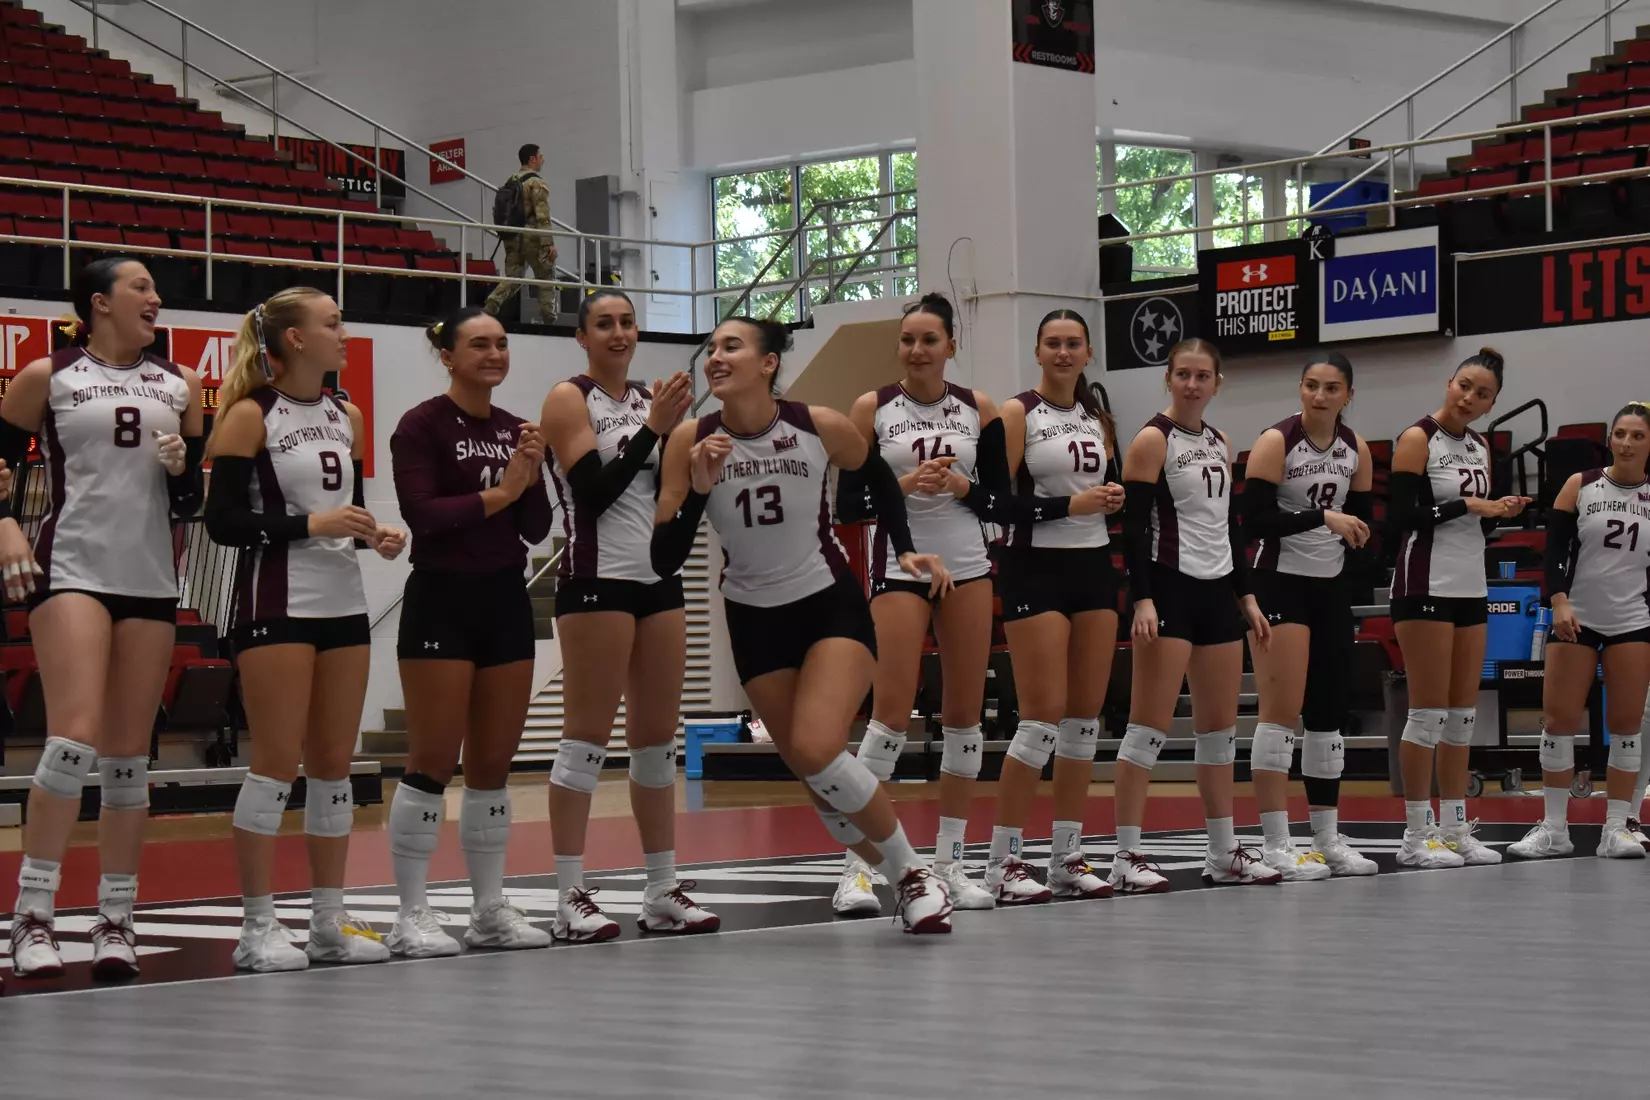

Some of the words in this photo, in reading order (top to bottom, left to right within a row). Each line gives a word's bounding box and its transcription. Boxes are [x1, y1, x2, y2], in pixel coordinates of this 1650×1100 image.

[1031, 50, 1078, 66] RESTROOMS
[1309, 239, 1325, 261] K
[1333, 268, 1427, 305] DASANI
[1542, 245, 1650, 324] LETS
[1216, 285, 1297, 316] PROTECT
[1215, 316, 1246, 337] THIS
[1249, 311, 1299, 334] HOUSE.
[72, 385, 129, 407] SOUTHERN
[114, 407, 141, 448] 8
[596, 414, 629, 435] OUTHERN
[889, 420, 934, 438] SOUTHERN
[936, 418, 971, 436] ILLINOIS
[1042, 423, 1079, 441] SOUTHERN
[278, 426, 323, 453] SOUTHERN
[911, 436, 956, 469] 14
[1067, 440, 1100, 473] 15
[319, 451, 343, 491] 9
[713, 459, 760, 485] UTHERN
[763, 459, 809, 478] ILLINOIS
[1202, 465, 1225, 498] 17
[1287, 462, 1326, 480] SOUTHERN
[1457, 468, 1488, 498] 20
[735, 484, 784, 528] 13
[1306, 482, 1337, 510] 18
[1586, 500, 1627, 516] SOUTHERN
[1603, 519, 1639, 551] 21
[1504, 669, 1524, 678] POWER
